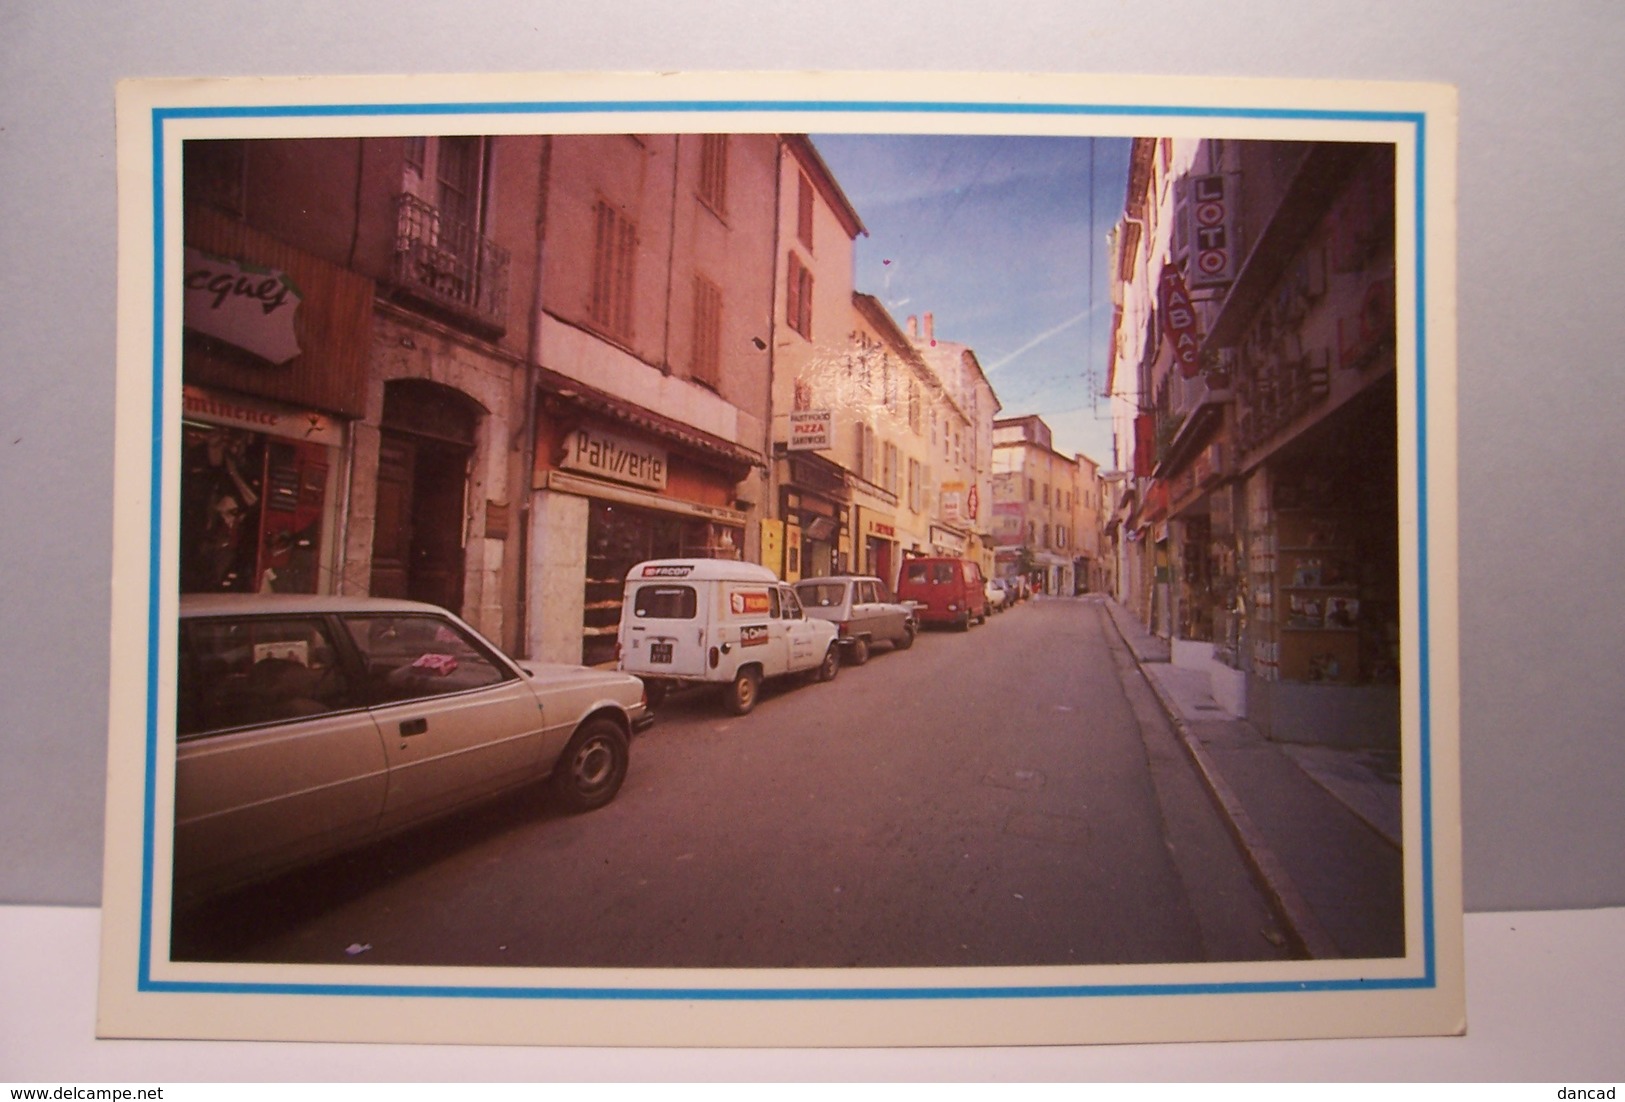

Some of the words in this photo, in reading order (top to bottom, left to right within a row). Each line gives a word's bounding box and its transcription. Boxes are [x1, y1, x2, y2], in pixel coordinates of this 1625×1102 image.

[1195, 177, 1226, 273] LOTO
[1164, 274, 1194, 363] TABAC
[795, 424, 824, 433] PIZZA
